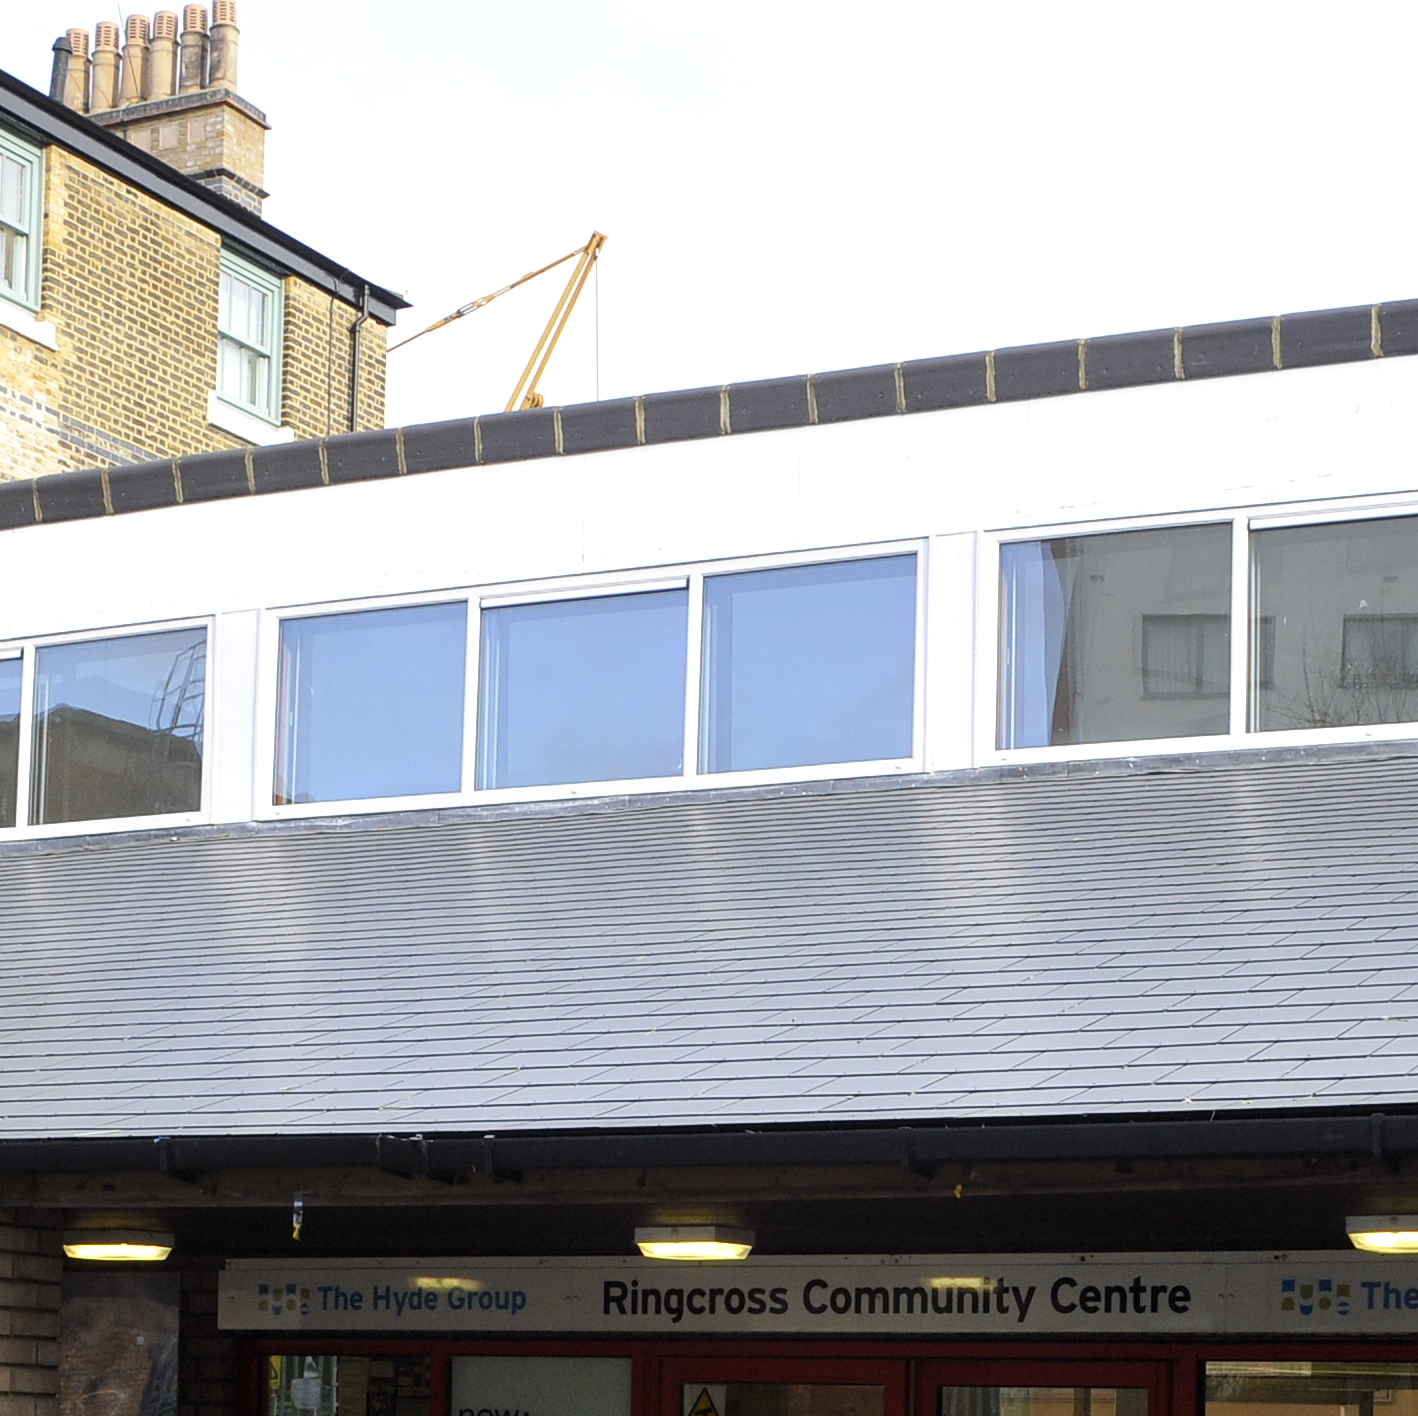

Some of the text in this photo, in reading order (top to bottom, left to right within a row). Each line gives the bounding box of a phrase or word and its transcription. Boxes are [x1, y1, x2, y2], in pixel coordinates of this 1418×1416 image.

[318, 1286, 526, 1316] The Hyde Group
[603, 1276, 1191, 1323] Ringcross Community Centre
